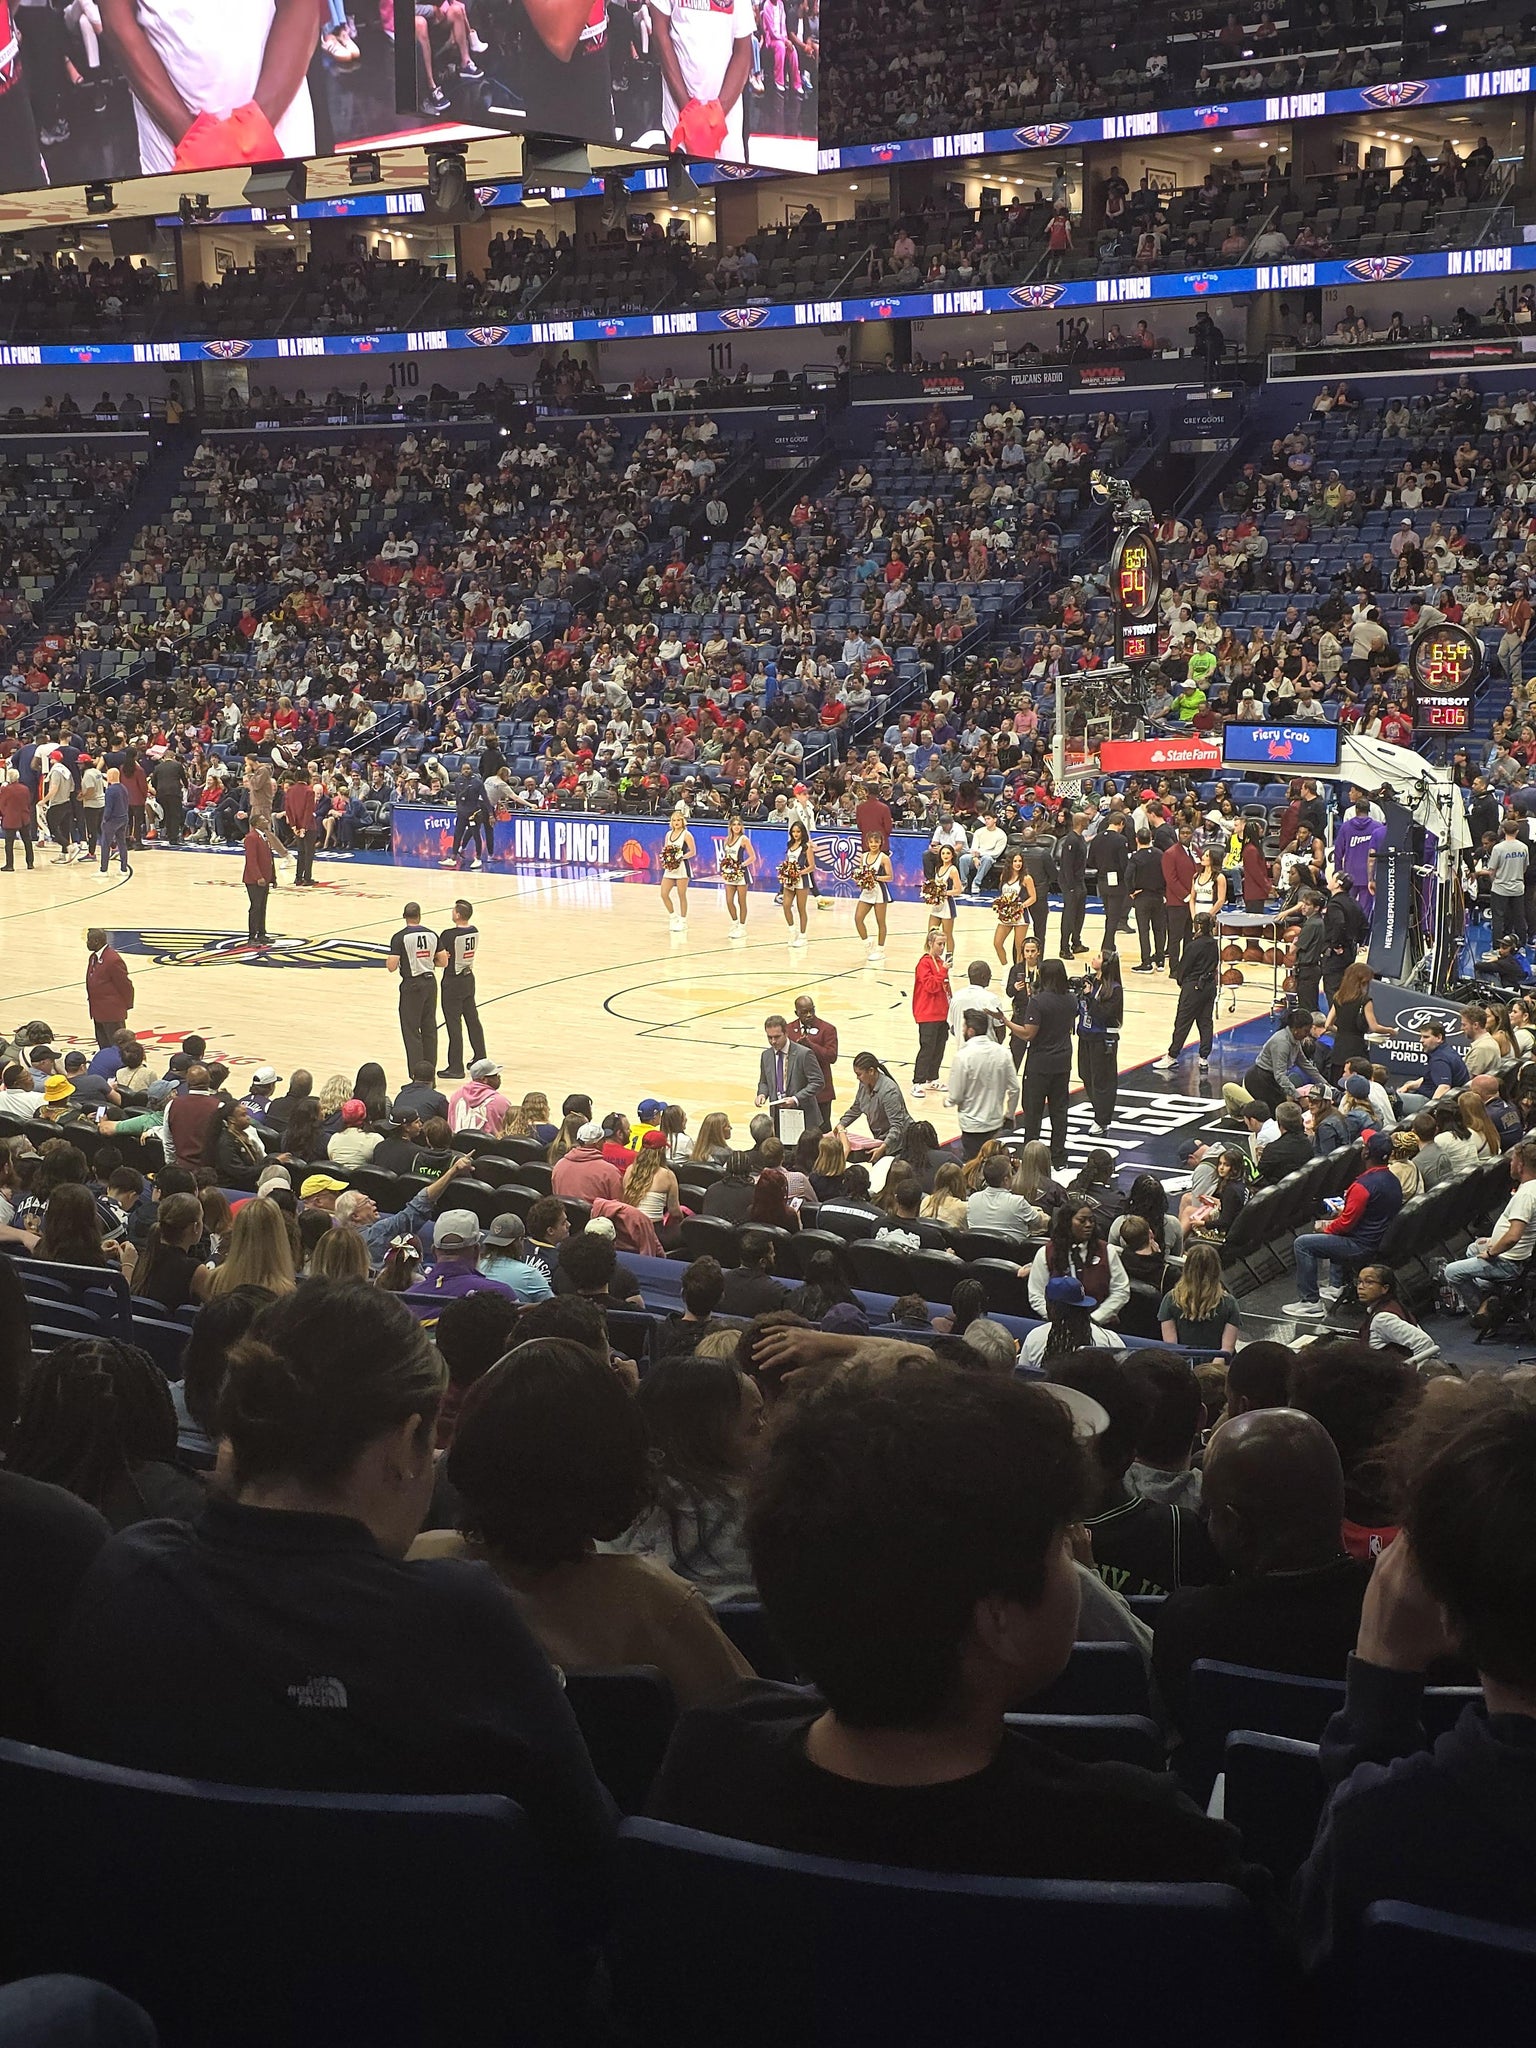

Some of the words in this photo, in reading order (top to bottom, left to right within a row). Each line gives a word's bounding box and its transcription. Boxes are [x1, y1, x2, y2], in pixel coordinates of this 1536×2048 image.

[1466, 74, 1479, 97] IN
[1481, 73, 1492, 96] A
[1494, 68, 1530, 95] PINCH
[1266, 98, 1279, 120] IN
[1279, 97, 1290, 119] A
[1291, 93, 1325, 118] PINCH
[1103, 117, 1115, 139] IN
[1116, 115, 1125, 138] A
[1127, 112, 1158, 137] PINCH
[933, 136, 945, 158] IN
[945, 135, 953, 157] A
[954, 132, 984, 155] PINCH
[818, 148, 841, 171] INCH
[1448, 252, 1461, 274] IN
[1462, 251, 1473, 273] A
[1475, 248, 1511, 272] PINCH
[1256, 267, 1269, 289] IN
[1269, 266, 1279, 288] A
[1281, 263, 1315, 287] PINCH
[1096, 280, 1108, 301] IN
[1108, 280, 1117, 300] A
[1119, 277, 1151, 300] PINCH
[933, 293, 944, 314] IN
[944, 293, 952, 313] A
[953, 290, 984, 313] PINCH
[653, 315, 664, 334] IN
[664, 315, 671, 333] A
[672, 313, 698, 333] PINCH
[795, 304, 806, 324] IN
[806, 304, 814, 324] A
[815, 302, 842, 323] PINCH
[532, 324, 542, 342] IN
[542, 323, 549, 342] A
[549, 322, 574, 341] PINCH
[133, 344, 145, 362] IN
[146, 344, 152, 361] A
[153, 343, 180, 361] PINCH
[278, 339, 289, 356] IN
[290, 338, 296, 356] A
[297, 337, 325, 356] PINCH
[708, 342, 732, 369] 111
[389, 361, 419, 387] 110
[1011, 373, 1042, 385] PELICANS
[1044, 371, 1063, 383] RADIO
[1121, 570, 1146, 607] 24
[1133, 623, 1157, 636] TISSOT
[1430, 662, 1460, 683] 24
[1430, 697, 1470, 706] TISSOT
[1431, 708, 1465, 725] 2:06
[1252, 729, 1280, 742] Fiery
[1283, 729, 1310, 743] Crab
[424, 815, 451, 831] Fiery
[515, 819, 535, 859] IN
[539, 821, 550, 860] A
[554, 823, 610, 864] PINCH
[1505, 851, 1526, 860] ABM
[416, 935, 428, 950] 41
[465, 936, 476, 951] 50
[1407, 1010, 1458, 1033] Fd
[1379, 1040, 1424, 1052] SOUTHE
[1391, 1051, 1418, 1063] FORD
